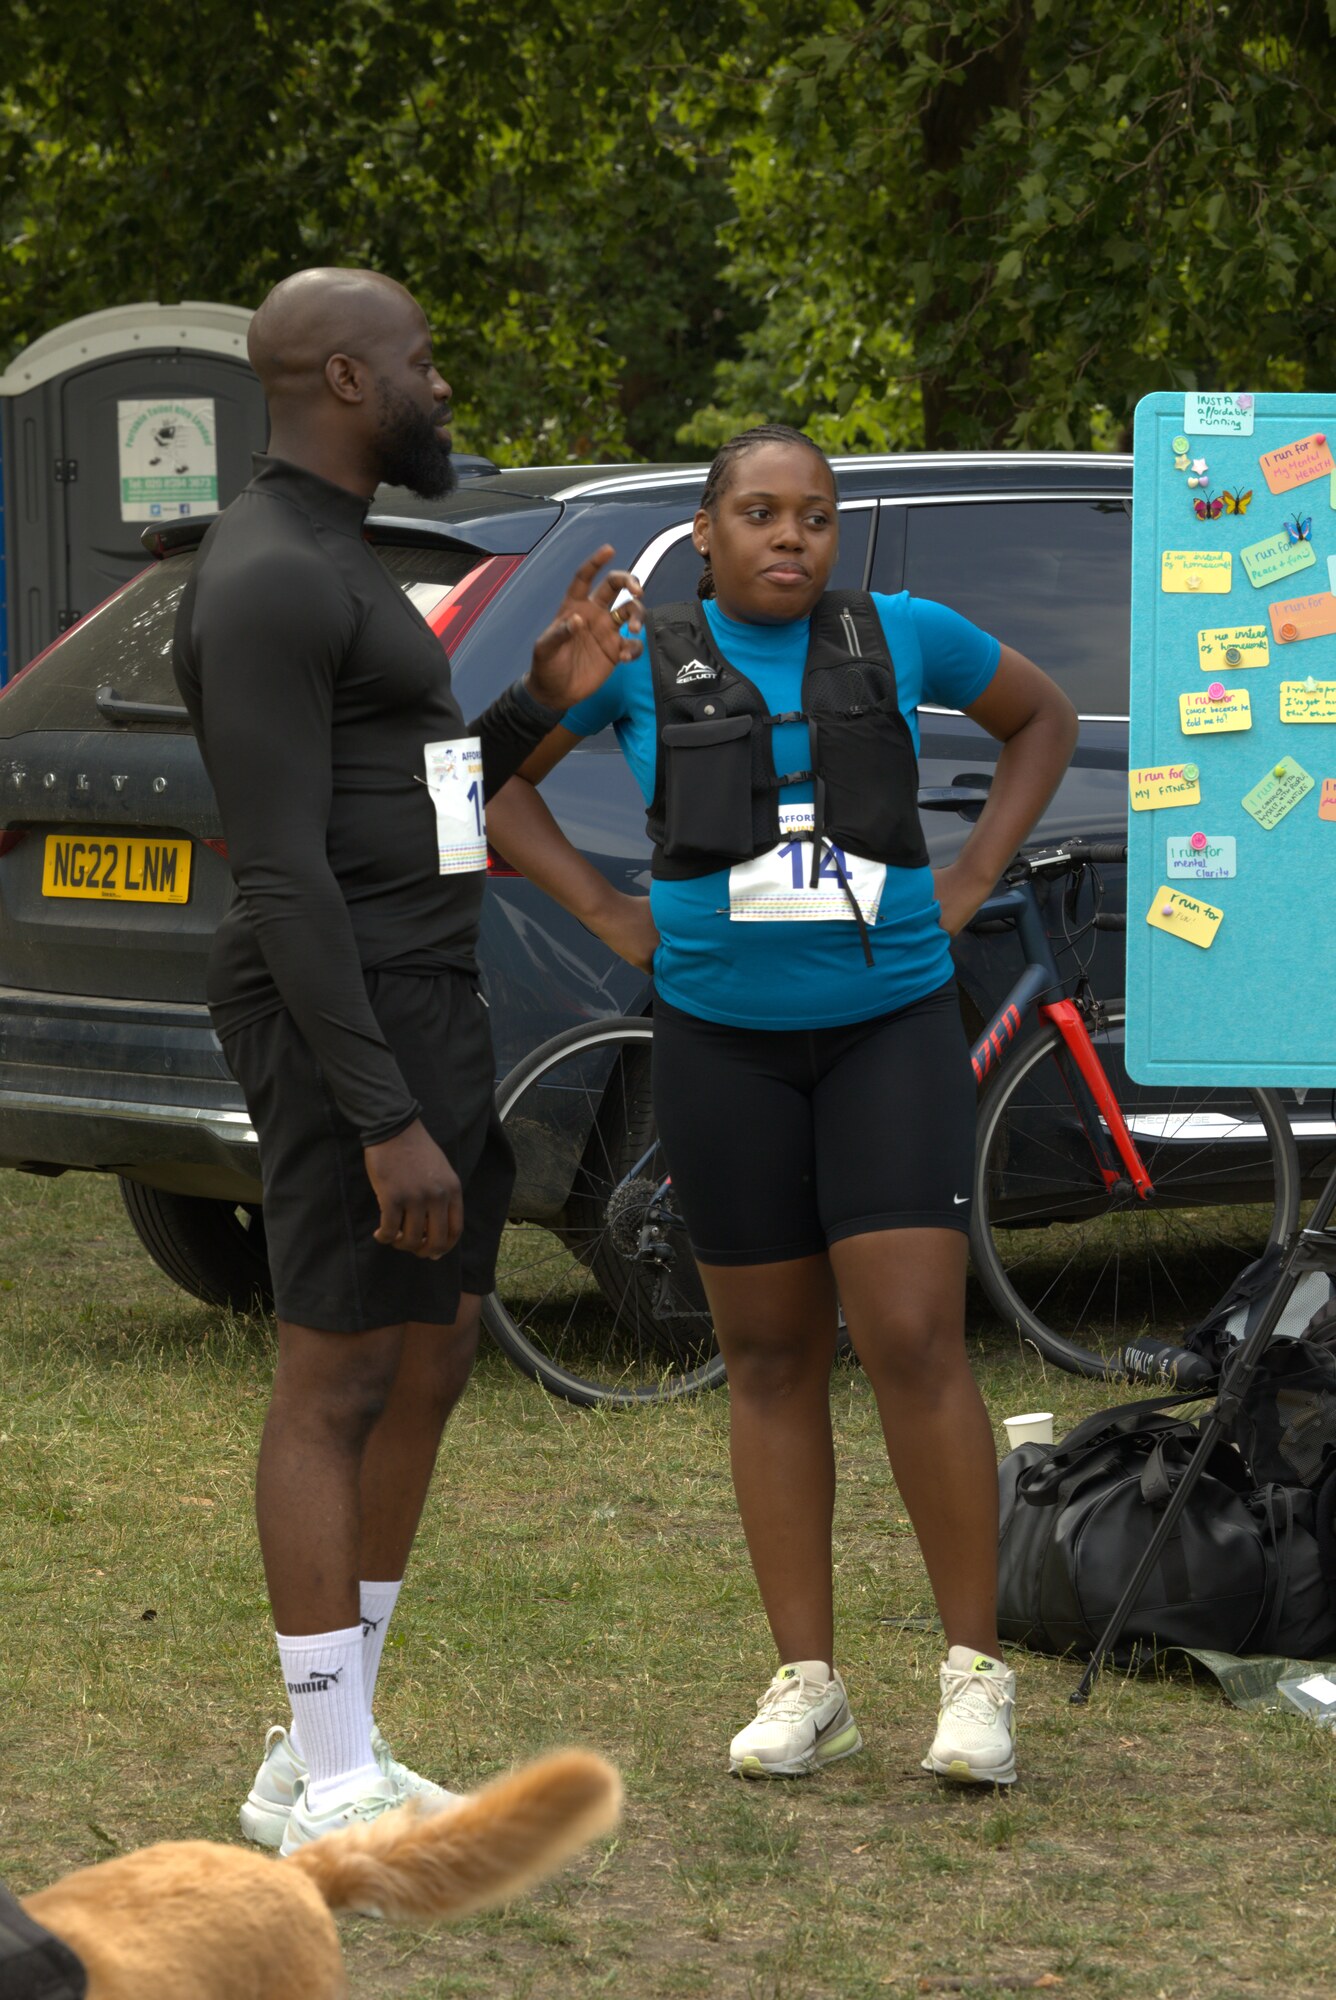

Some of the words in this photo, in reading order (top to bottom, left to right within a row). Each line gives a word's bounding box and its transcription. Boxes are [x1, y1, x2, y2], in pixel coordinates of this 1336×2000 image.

[1197, 395, 1233, 406] INSTA
[1200, 418, 1242, 431] running
[1264, 457, 1271, 467] I
[1274, 450, 1294, 463] run
[1294, 442, 1311, 455] for
[1273, 467, 1291, 480] My
[1295, 458, 1332, 481] HEALTH
[1245, 556, 1252, 566] I
[1255, 547, 1278, 562] run
[1274, 605, 1279, 616] I
[1284, 602, 1306, 615] run
[1307, 597, 1325, 609] for
[1201, 632, 1206, 641] I
[1187, 695, 1191, 706] I
[12, 772, 168, 793] VOLVO
[1138, 772, 1142, 784] I
[1144, 772, 1165, 782] run
[1135, 789, 1150, 799] MY
[1257, 781, 1275, 800] run
[1171, 848, 1175, 858] I
[1204, 845, 1223, 858] for
[53, 842, 118, 889] NG22
[124, 845, 178, 892] LNM
[777, 840, 853, 889] 14
[1173, 858, 1207, 868] mental
[1179, 898, 1200, 913] run
[1203, 908, 1220, 921] for
[1136, 1115, 1211, 1125] RECHARGE
[287, 1680, 328, 1695] PUMA
